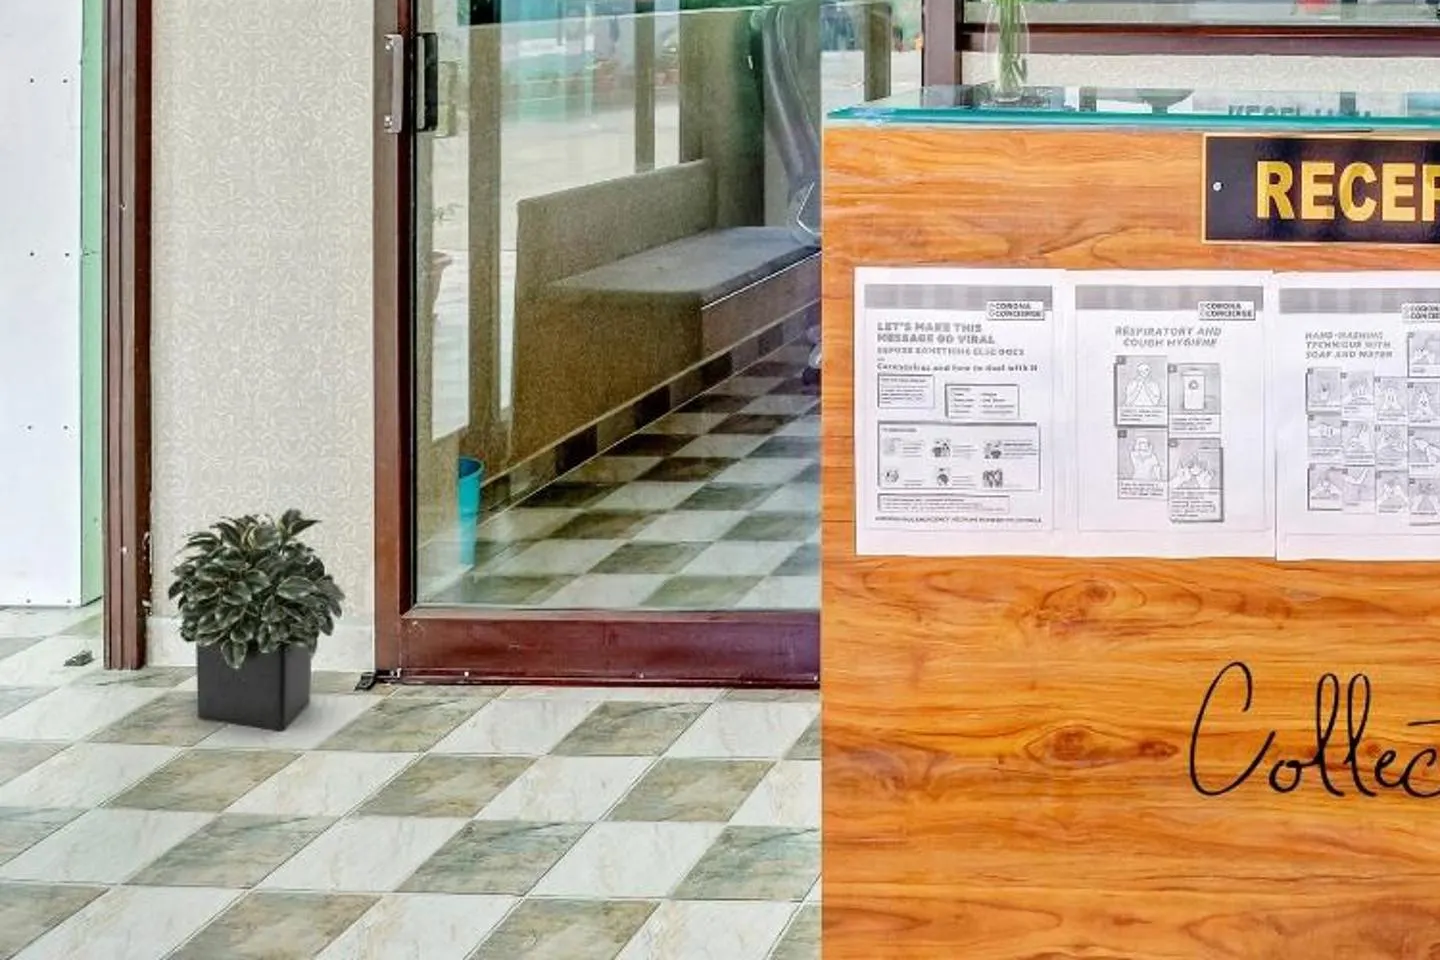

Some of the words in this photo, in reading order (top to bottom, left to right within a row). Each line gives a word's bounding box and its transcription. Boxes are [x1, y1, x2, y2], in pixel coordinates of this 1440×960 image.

[877, 322, 912, 332] LET'S
[915, 322, 950, 332] MAKE
[955, 323, 983, 333] THIS
[1115, 325, 1193, 337] RESPIRATORY
[1197, 326, 1222, 336] AND
[877, 333, 935, 343] MESSAGE
[936, 335, 955, 344] GO
[957, 335, 996, 344] VIRAL
[1123, 337, 1164, 348] COUGH
[1166, 338, 1218, 348] HYGIENE
